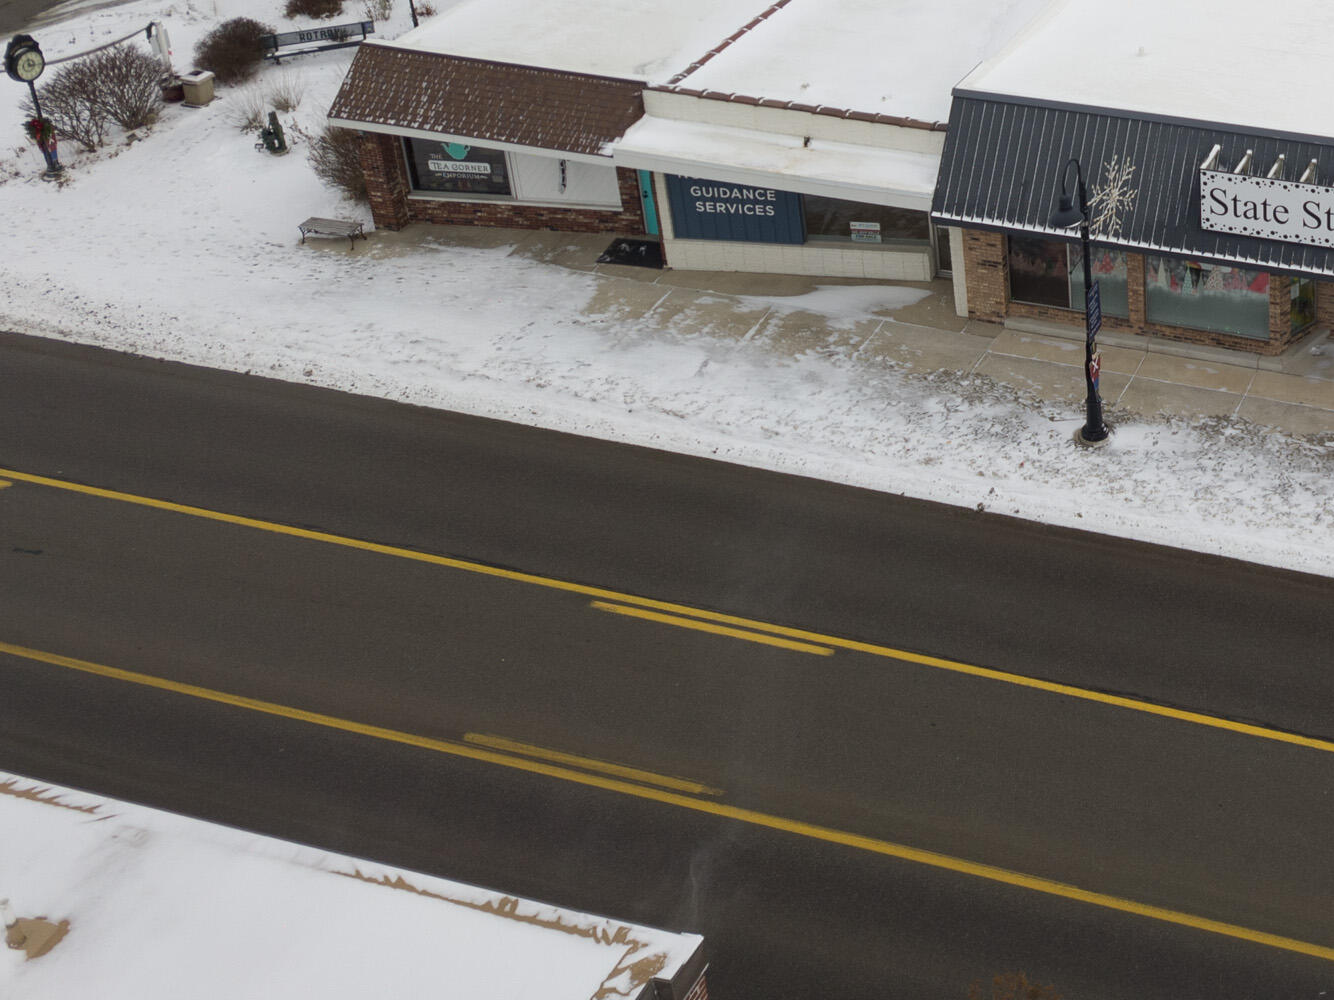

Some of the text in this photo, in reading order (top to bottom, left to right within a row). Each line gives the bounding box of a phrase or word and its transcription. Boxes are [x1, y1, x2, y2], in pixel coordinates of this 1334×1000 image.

[431, 161, 489, 173] TEA CORNER
[690, 186, 776, 201] GUIDANCE
[695, 201, 775, 216] SERVICES
[1209, 187, 1290, 224] State
